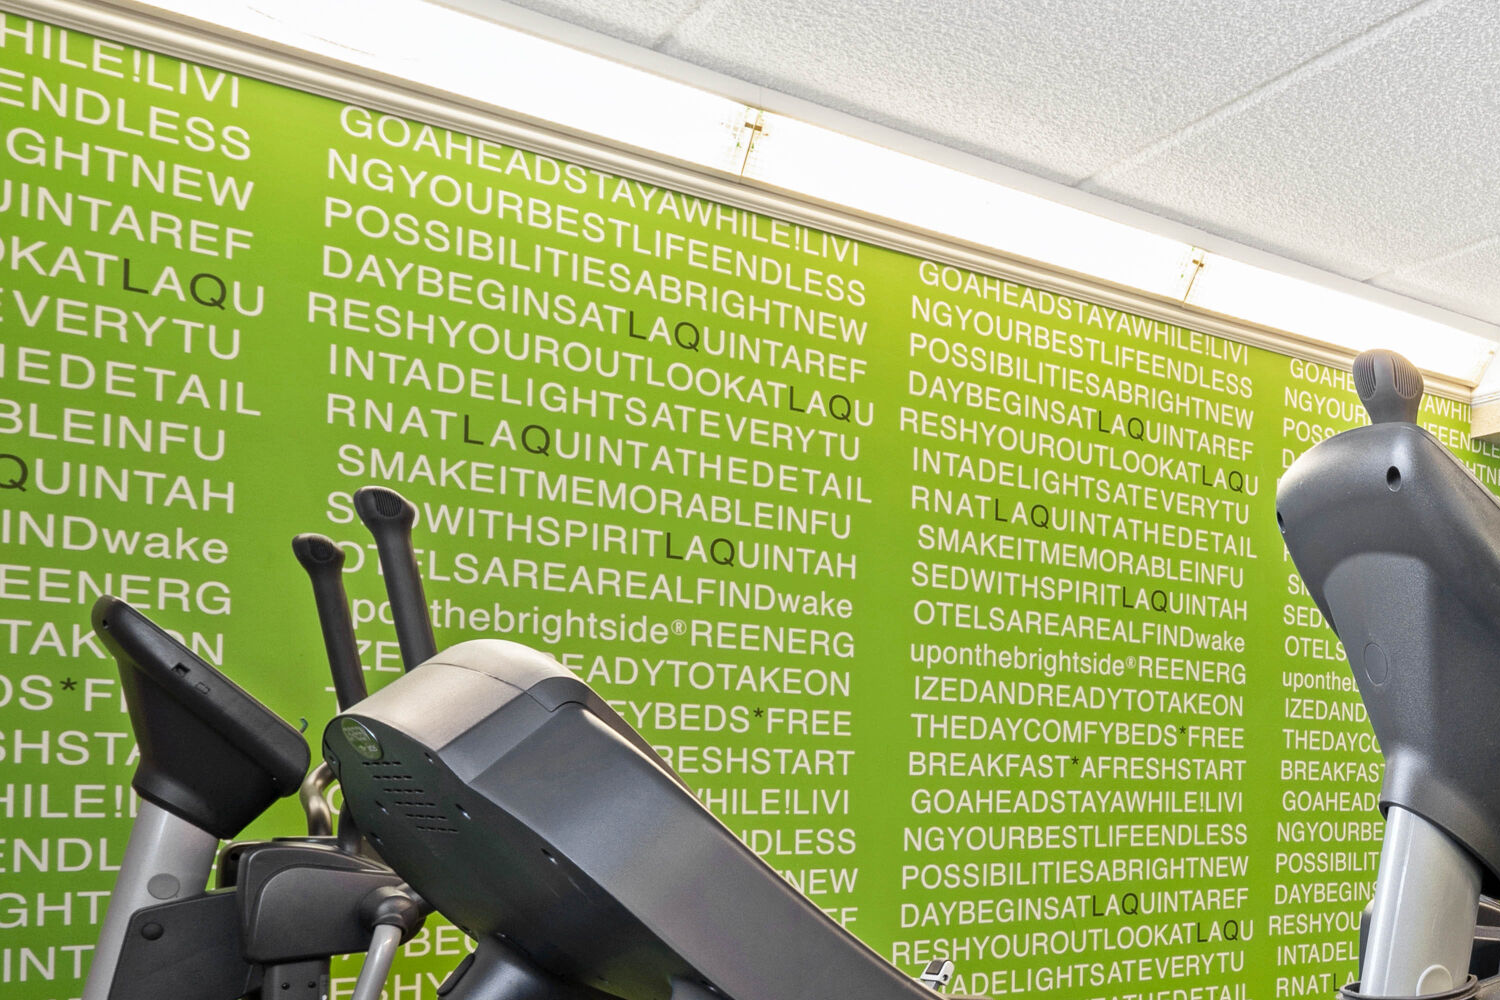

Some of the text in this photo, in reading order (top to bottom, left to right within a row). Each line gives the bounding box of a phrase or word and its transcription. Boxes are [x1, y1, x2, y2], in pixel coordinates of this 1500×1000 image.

[6, 127, 254, 211] GHTNEW
[328, 148, 866, 307] NGYOURBESTLIFEENDLESS
[0, 235, 264, 316] KATLAQU
[324, 196, 868, 346] POSSIBILITIESABRIGHTNEW
[0, 288, 240, 361] VERYTU
[322, 245, 868, 384] DAYBEGINSATLAQUINTAREF
[911, 295, 1253, 398] NGYOURBESTLIFEENDLESS
[0, 343, 261, 416] EDETAIL
[308, 292, 875, 427] RESHYOUROUTLOOKATLAQU
[909, 334, 1254, 431] POSSIBILITIESABRIGHTNEW
[329, 344, 860, 461] INTADELIGHTSATEVERYTU
[908, 371, 1253, 462] DAYBEGINSATLAQUINTAREF
[1285, 387, 1370, 424] NGYOUR
[899, 408, 1258, 497] RESHYOUROUTLOOKATLAQU
[912, 447, 1249, 525] INTADELIGHTSATEVERYTU
[337, 445, 851, 540] SMAKEITMEMORABLEINFU
[3, 509, 228, 564] INDwake
[918, 526, 1243, 588] SMAKEITMEMORABLEINFU
[911, 563, 1247, 621] SEDWITHSPIRITLAQUINTAH
[913, 601, 1245, 654] OTELSAREAREALFINDwake
[914, 676, 1243, 716] IZEDANDREADYTOTAKEON
[697, 789, 849, 815] HILE!LIVI
[904, 824, 1248, 852] NGYOURBESTLIFEENDLESS
[911, 789, 1243, 815] GOAHEADSTAYAWHILE!LIVI
[900, 888, 1249, 928] DAYBEGINSATLAQUINTAREF
[901, 856, 1249, 890] POSSIBILITIESABRIGHTNEW
